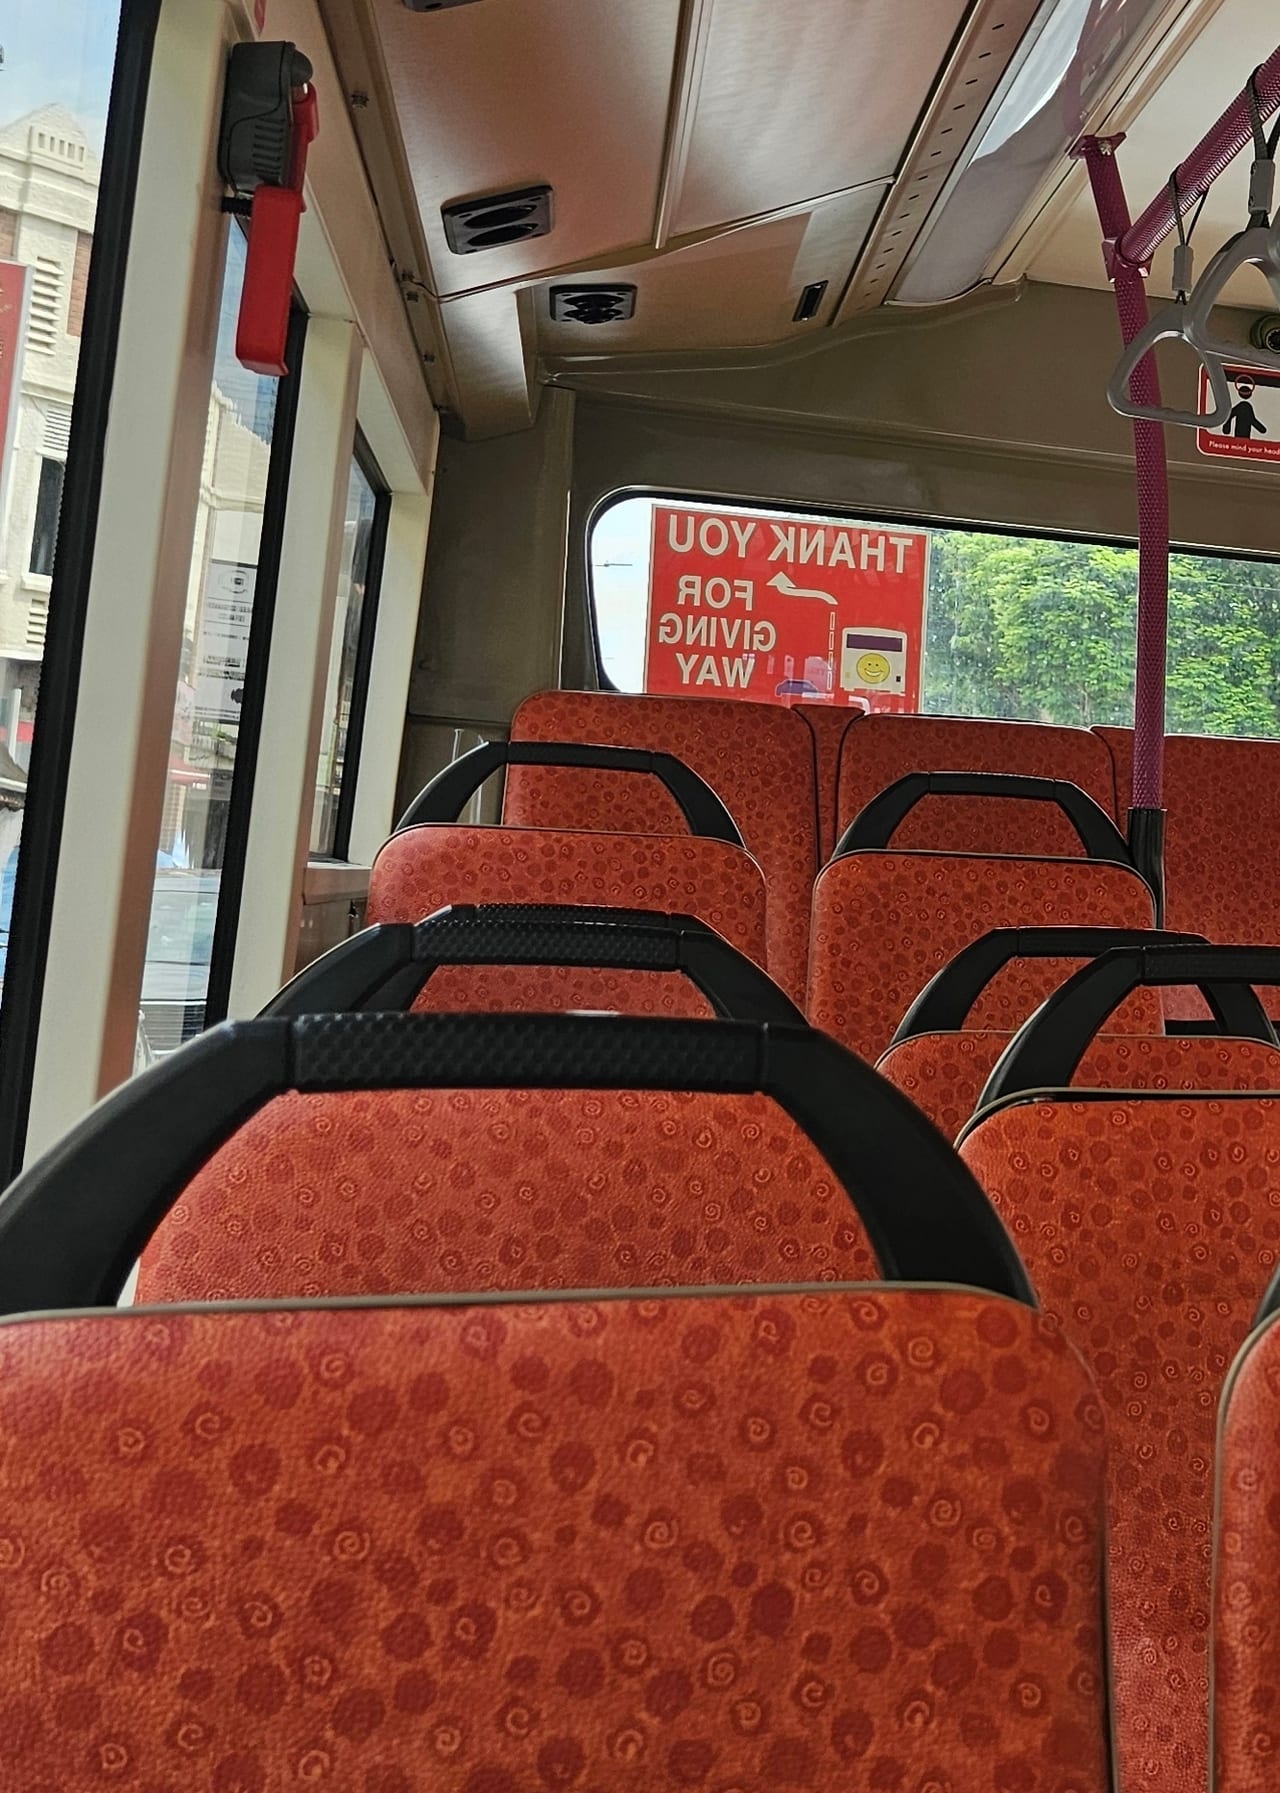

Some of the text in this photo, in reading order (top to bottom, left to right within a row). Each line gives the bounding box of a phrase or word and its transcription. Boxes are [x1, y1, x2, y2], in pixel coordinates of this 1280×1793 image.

[1208, 440, 1280, 455] Please mind your head
